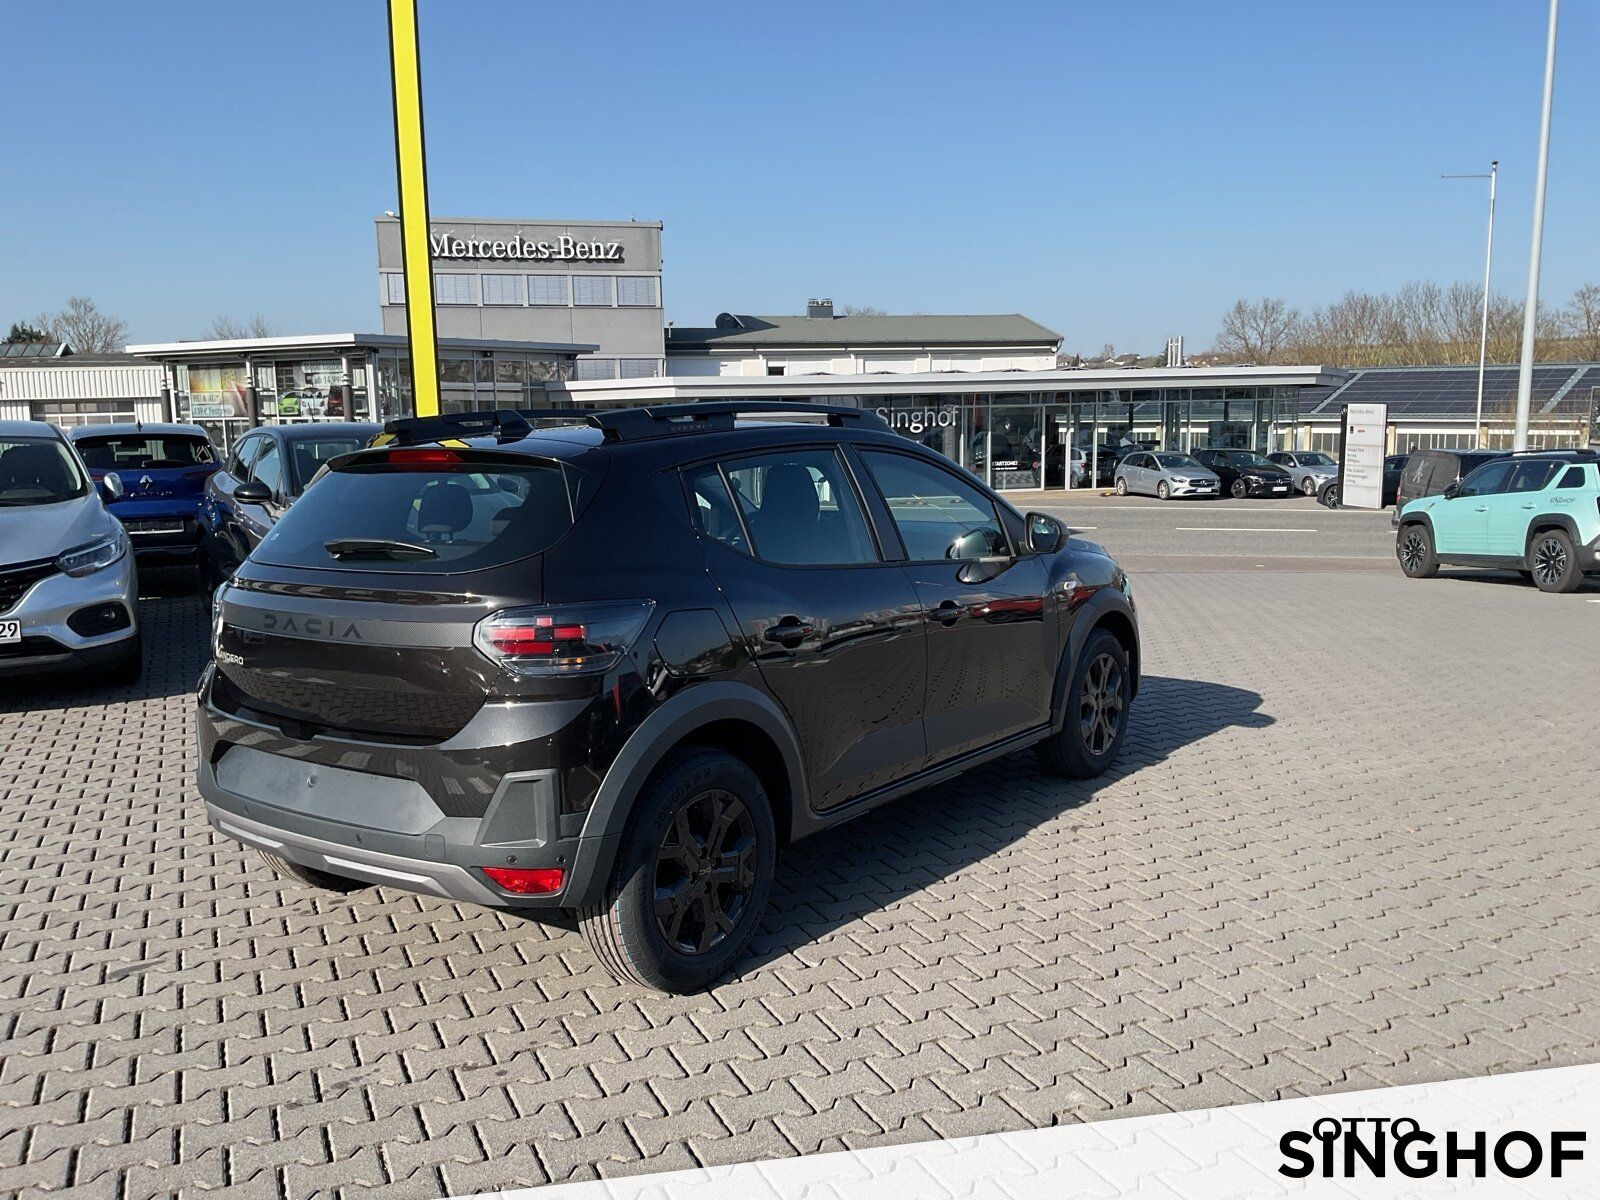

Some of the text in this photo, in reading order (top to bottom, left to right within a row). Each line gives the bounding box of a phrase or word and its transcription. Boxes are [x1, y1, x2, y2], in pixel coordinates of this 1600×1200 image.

[430, 233, 619, 259] Mercedes-Benz
[875, 404, 959, 433] Singhof
[263, 613, 362, 639] DACIA
